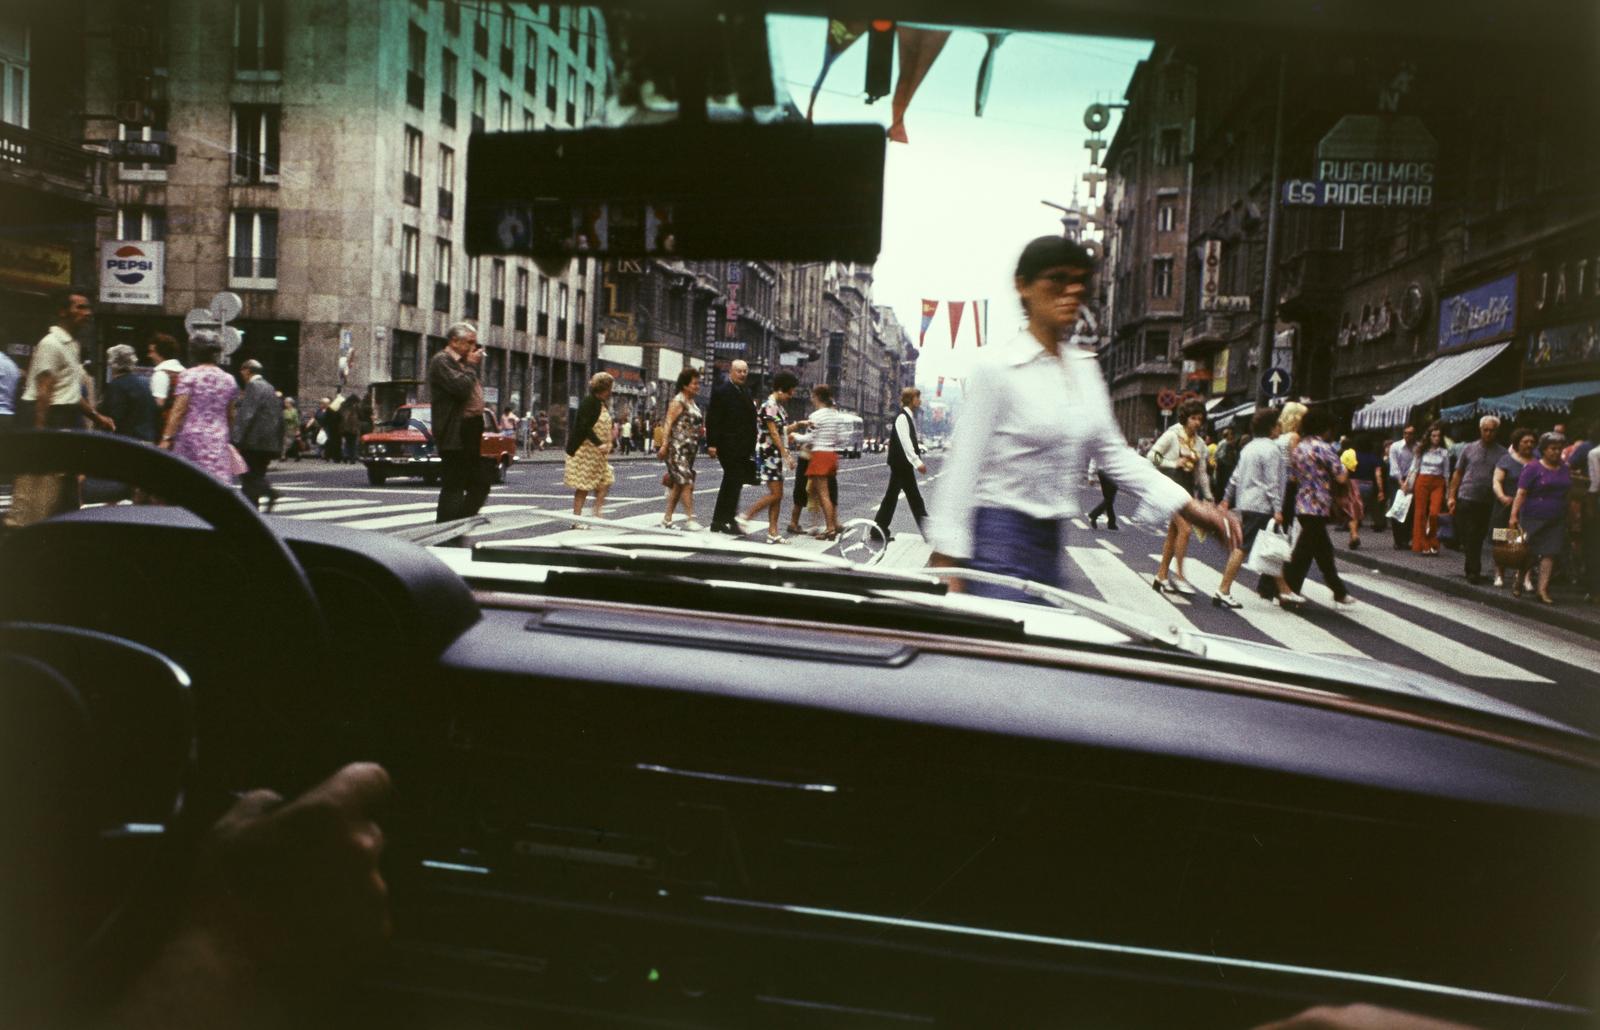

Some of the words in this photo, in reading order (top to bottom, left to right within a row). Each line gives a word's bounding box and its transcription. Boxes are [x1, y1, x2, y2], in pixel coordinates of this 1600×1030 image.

[1320, 160, 1435, 183] RUGALMAS
[1324, 183, 1433, 206] RIDEGHAB
[107, 259, 153, 270] PEPSI
